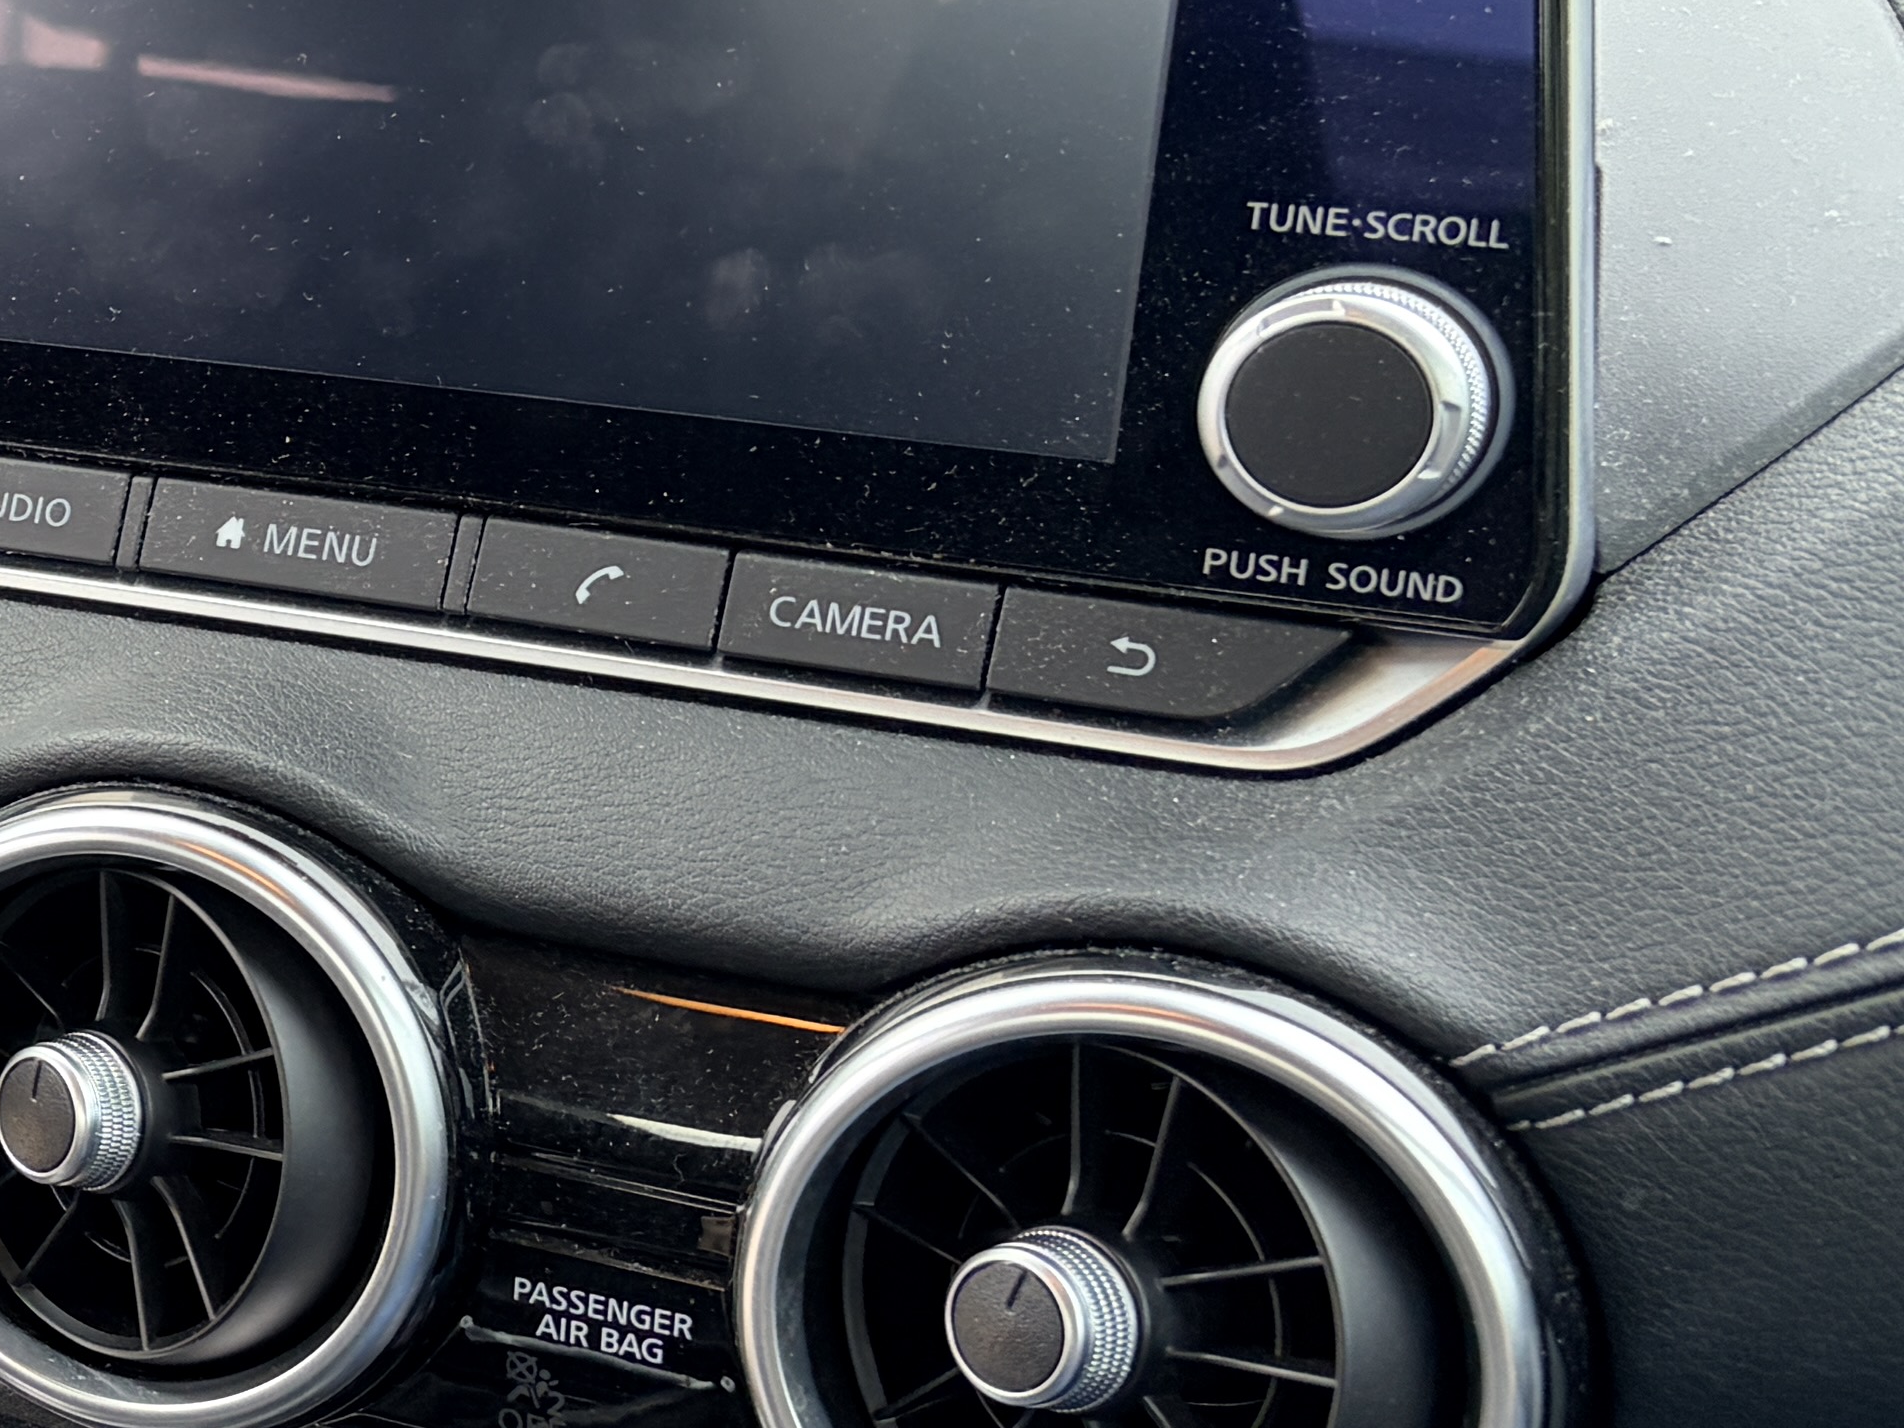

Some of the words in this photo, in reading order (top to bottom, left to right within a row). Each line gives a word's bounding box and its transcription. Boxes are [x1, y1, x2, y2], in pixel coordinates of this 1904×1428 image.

[263, 523, 377, 567] MENU
[1203, 547, 1309, 587] PUSH
[1325, 561, 1464, 605] SOUND
[768, 594, 942, 650] CAMERA
[512, 1276, 693, 1341] PASSENGER
[534, 1312, 589, 1348] AIR
[599, 1325, 664, 1365] BAG
